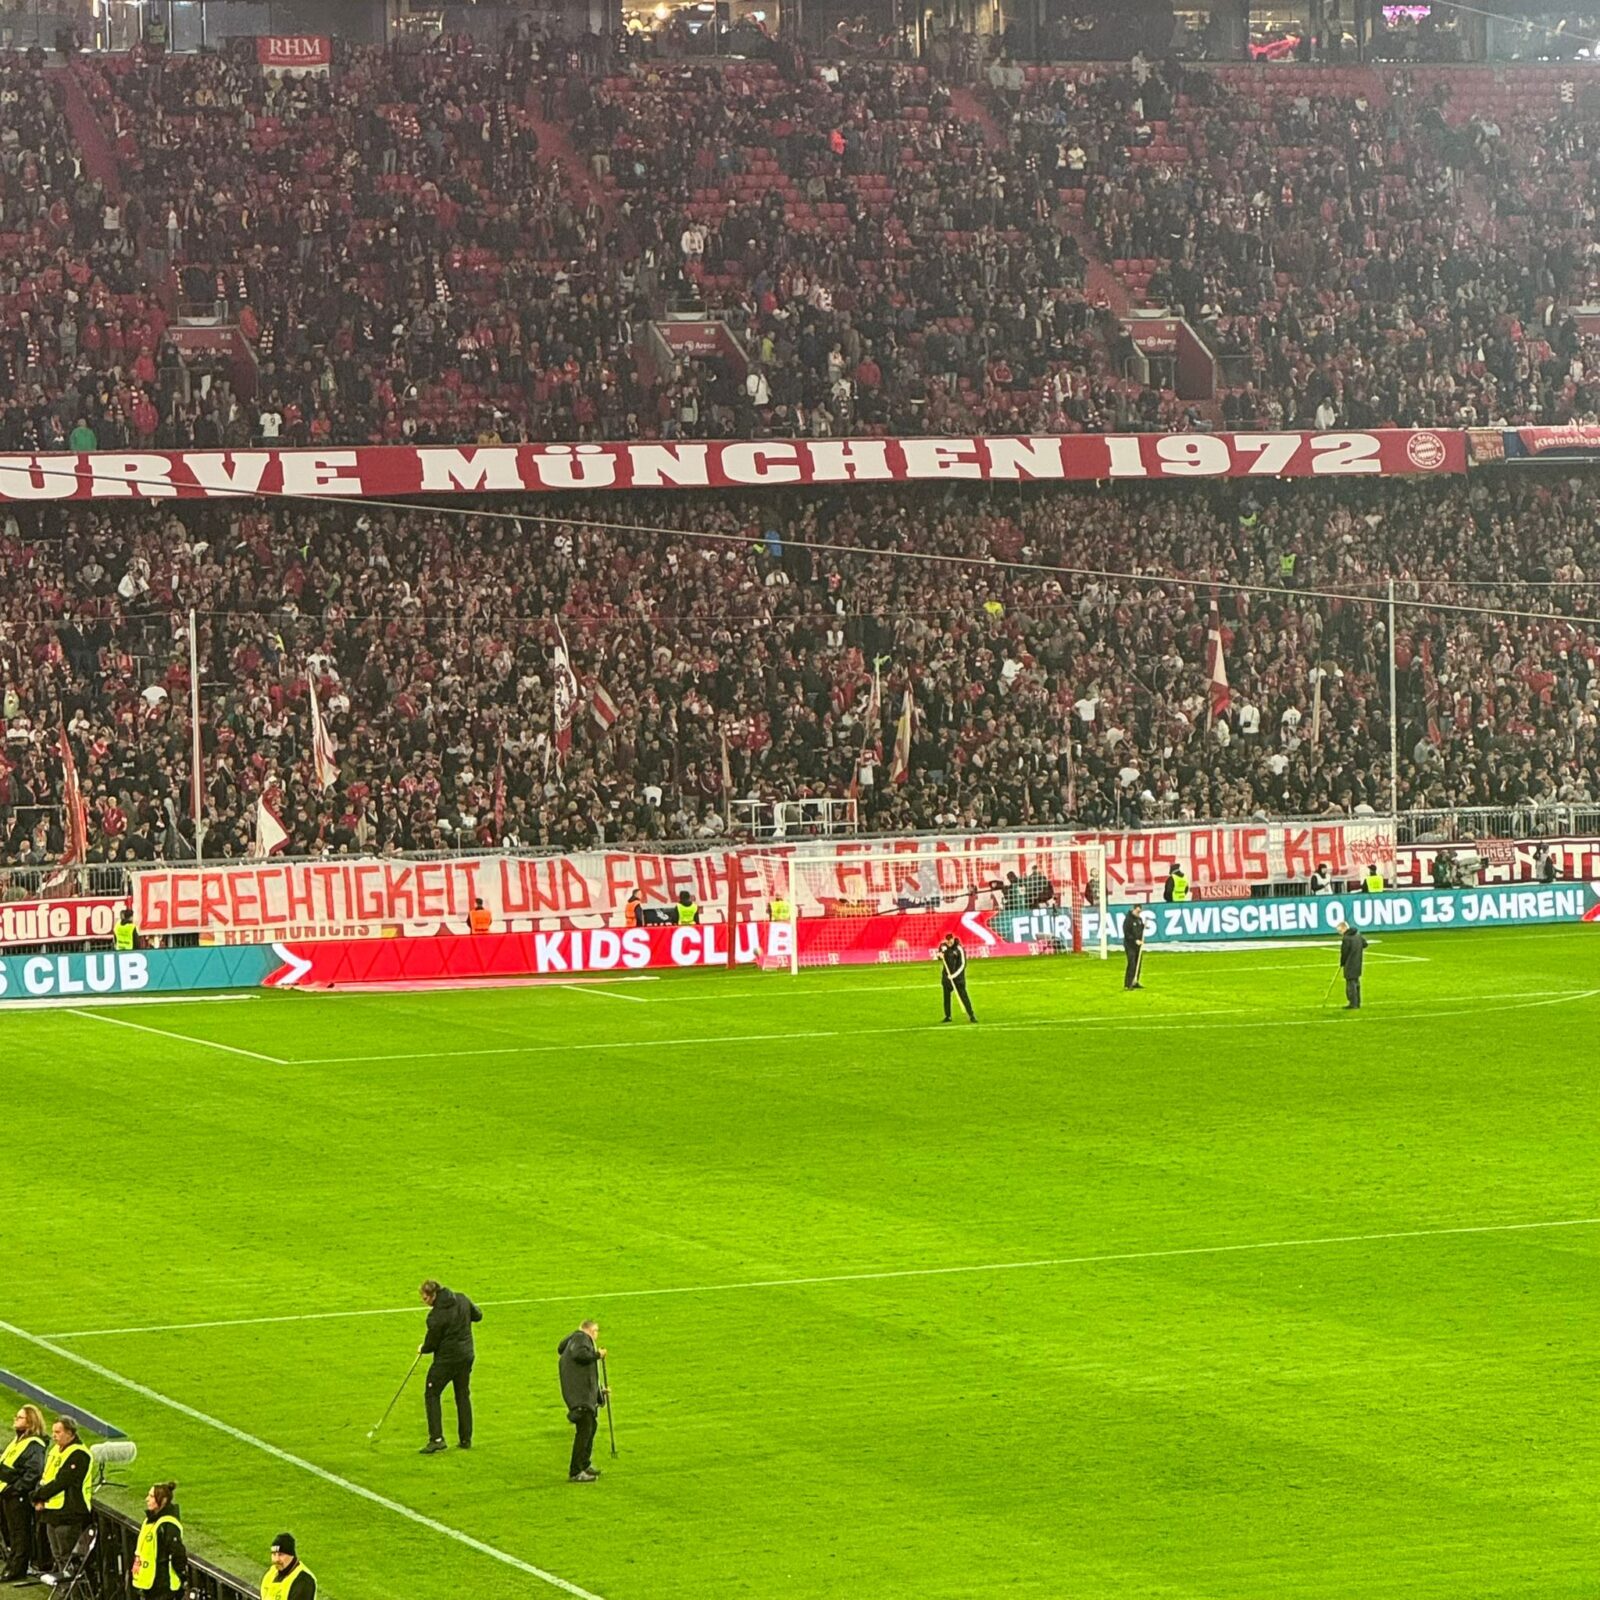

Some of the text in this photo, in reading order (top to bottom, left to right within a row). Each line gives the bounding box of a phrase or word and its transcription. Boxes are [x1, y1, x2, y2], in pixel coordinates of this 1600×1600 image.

[269, 38, 322, 56] RHM
[0, 451, 363, 499] URVE
[1105, 433, 1382, 476] 1972
[140, 861, 480, 931] GERECHTIGKEIT
[500, 858, 591, 913] UND
[604, 846, 797, 908] FREIHEIT
[1190, 828, 1269, 882] AUS
[0, 901, 126, 941] tufe rot
[1012, 909, 1072, 943] FÜR
[1083, 910, 1157, 940] FAS
[1164, 902, 1318, 935] ZWISCHEN
[1353, 898, 1412, 926] UND
[1421, 896, 1454, 922] 13
[1462, 889, 1585, 921] JAHREN!
[535, 928, 651, 972] KIDS
[671, 922, 792, 967] CLUB
[24, 953, 149, 995] CLUB
